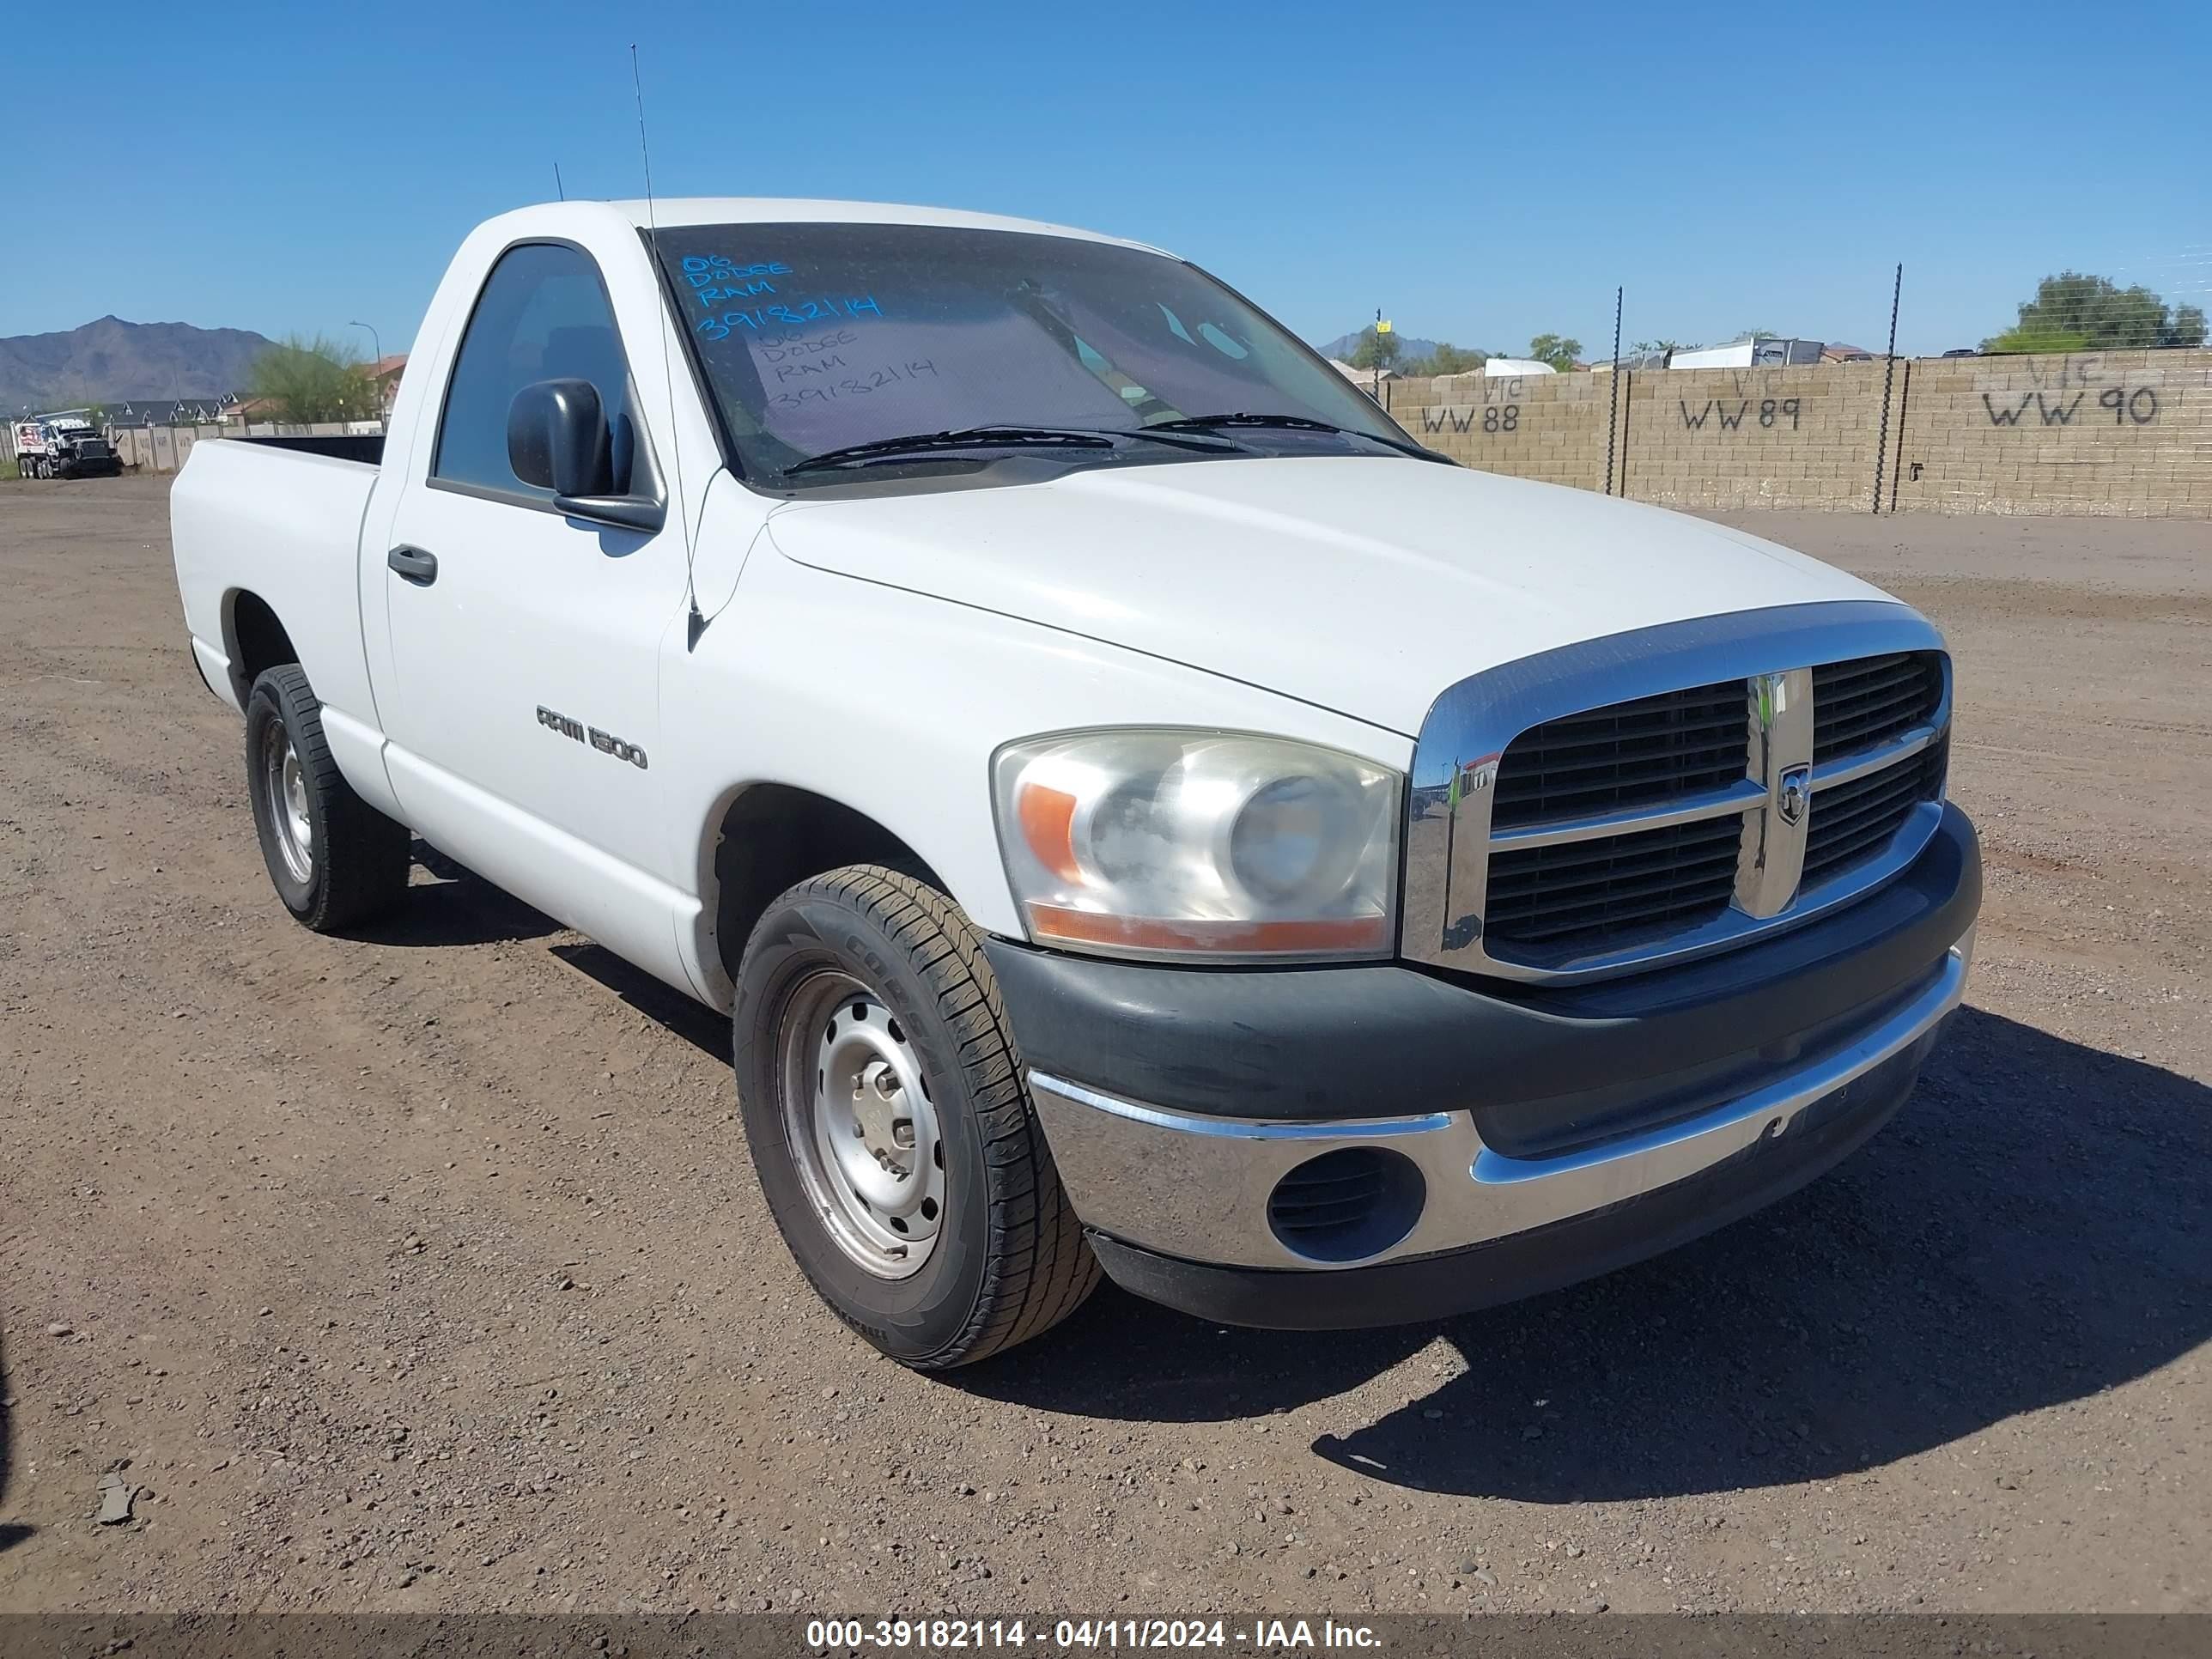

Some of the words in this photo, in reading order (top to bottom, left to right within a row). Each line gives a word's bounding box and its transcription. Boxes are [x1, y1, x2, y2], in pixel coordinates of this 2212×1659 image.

[682, 255, 732, 272] 06
[686, 262, 793, 288] DODGE
[699, 281, 776, 307] RAM
[696, 295, 883, 340] 39182114
[761, 331, 858, 362] DODGE
[769, 359, 939, 409] 39182114
[776, 355, 846, 383] RAM
[1422, 406, 1474, 433] WW
[1485, 404, 1519, 432] 88
[1680, 400, 1748, 429] WW
[1759, 398, 1800, 430] 89
[1982, 392, 2085, 426] WW
[2100, 386, 2157, 425] 90
[537, 704, 586, 744] RAM
[587, 726, 648, 770] 1500
